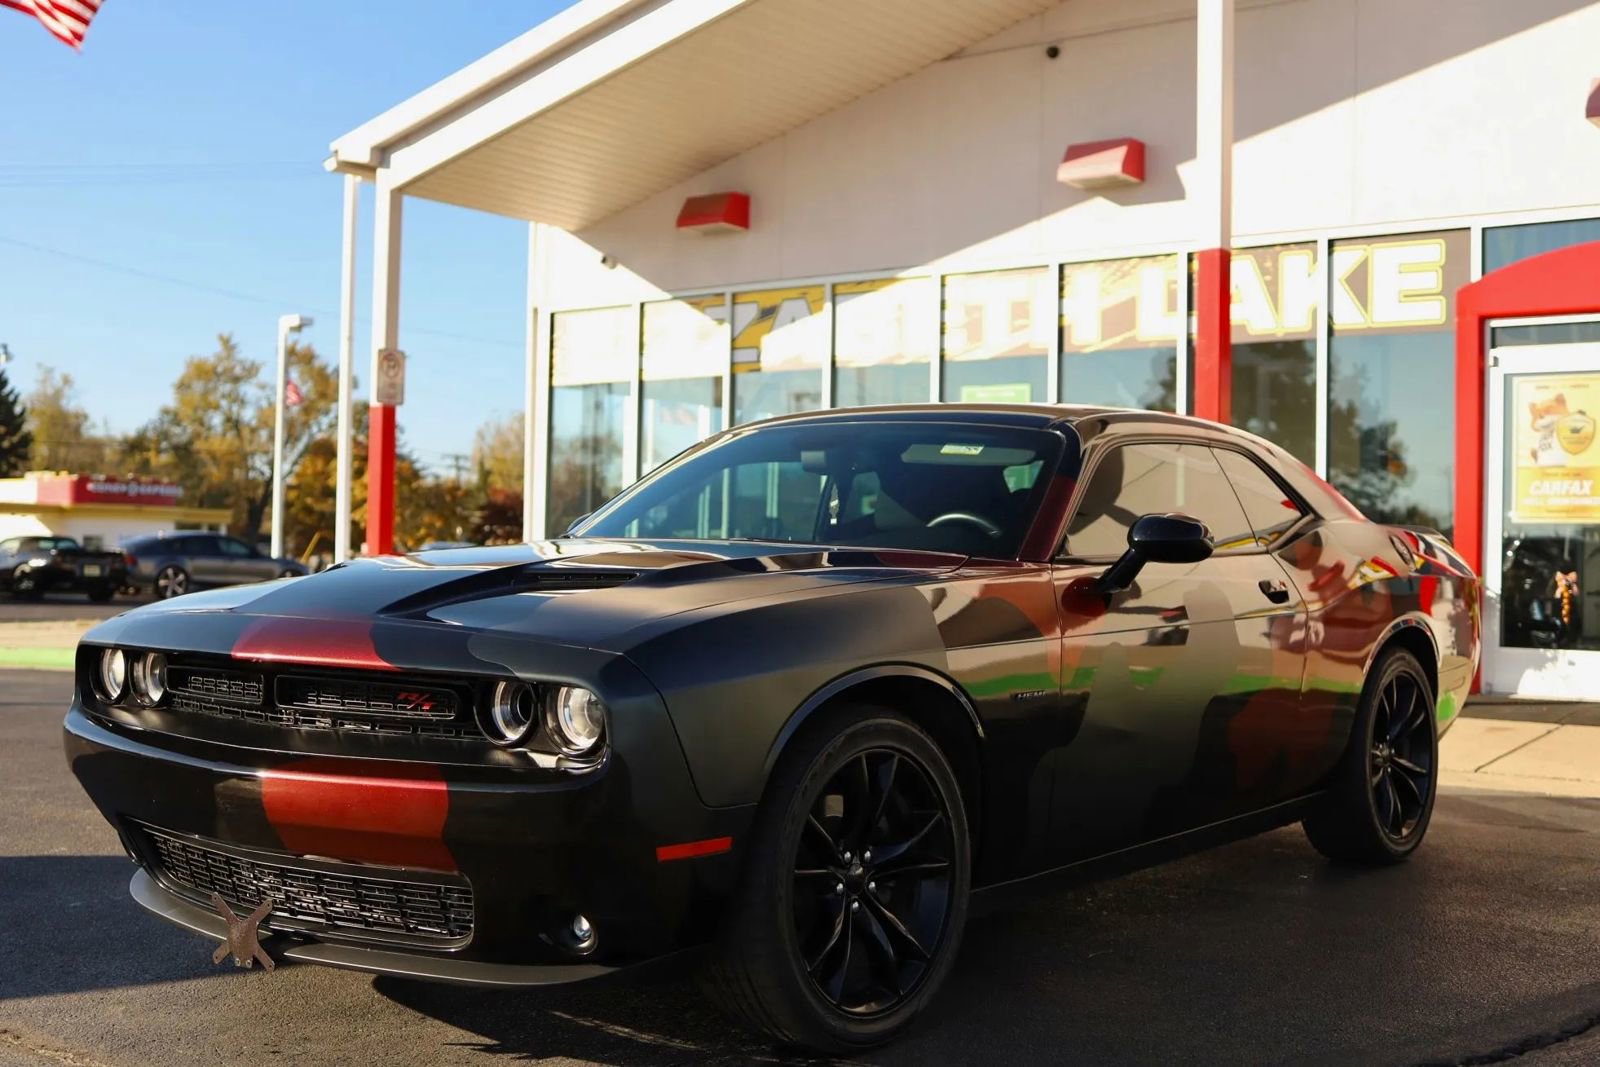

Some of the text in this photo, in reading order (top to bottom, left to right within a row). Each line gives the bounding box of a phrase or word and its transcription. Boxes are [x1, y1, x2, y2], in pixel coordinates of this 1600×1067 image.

[1134, 239, 1446, 342] LAKE
[1529, 479, 1595, 497] CARFAX
[397, 691, 434, 711] R/T
